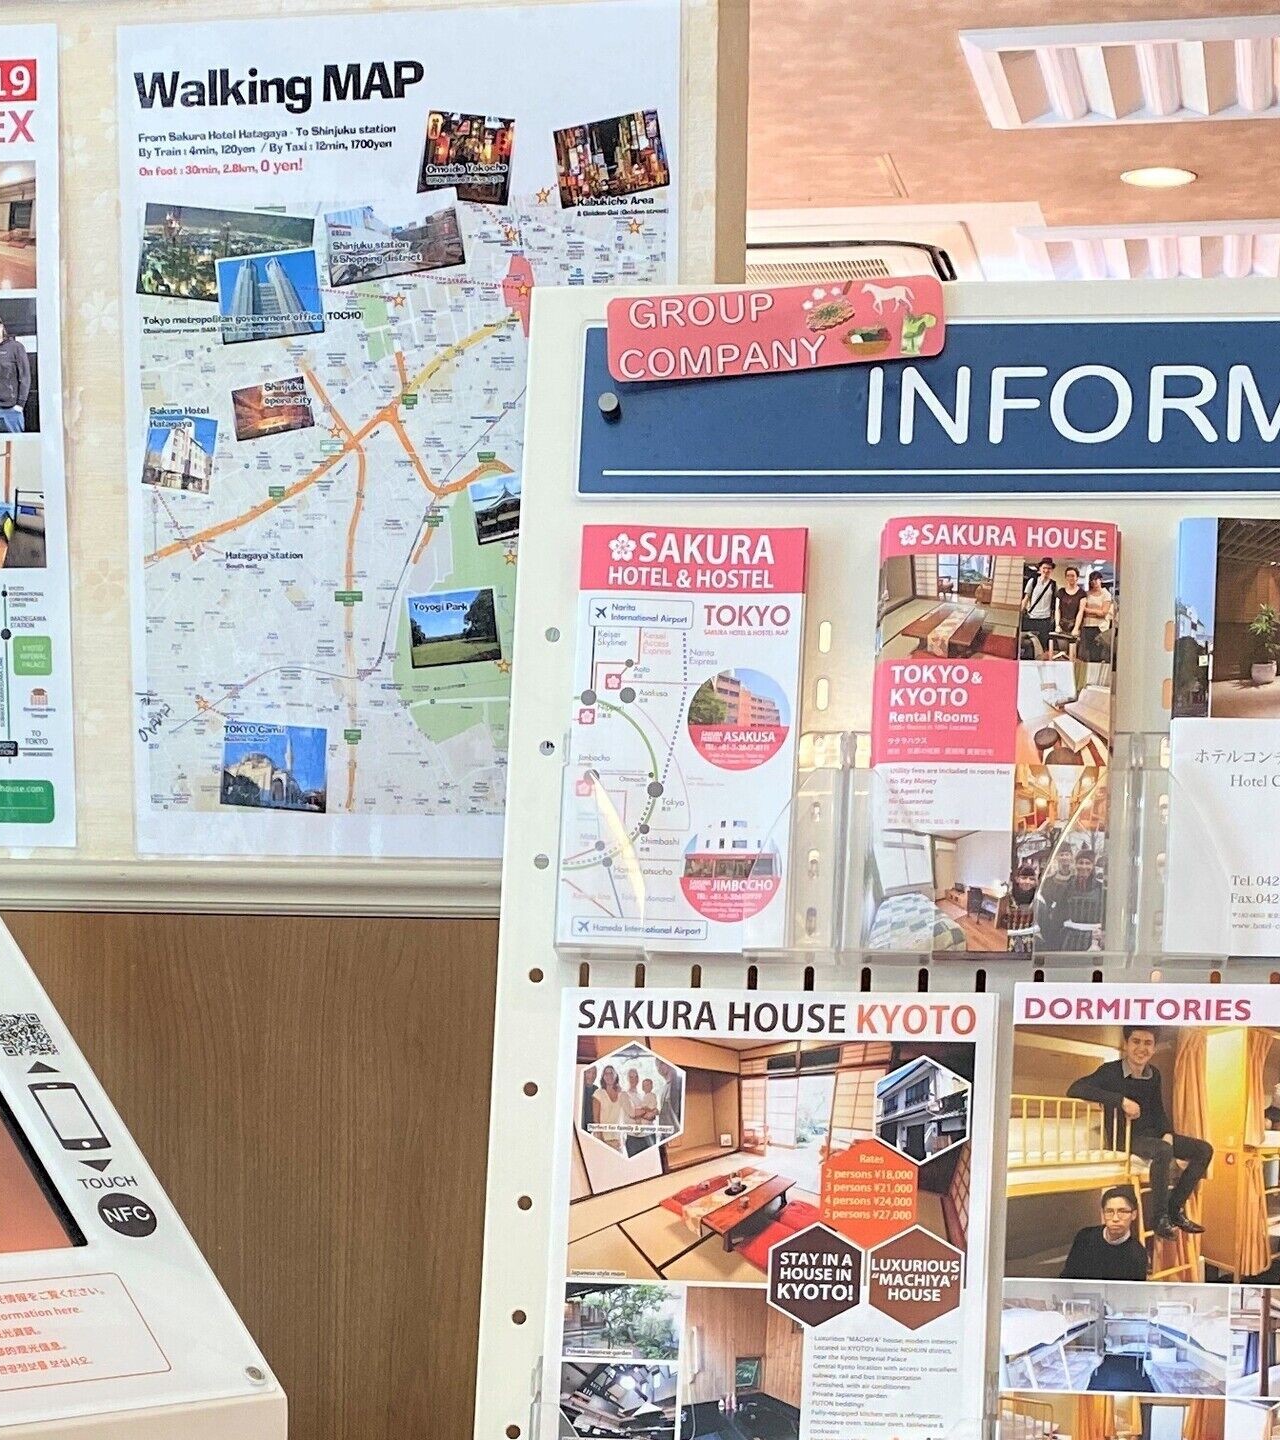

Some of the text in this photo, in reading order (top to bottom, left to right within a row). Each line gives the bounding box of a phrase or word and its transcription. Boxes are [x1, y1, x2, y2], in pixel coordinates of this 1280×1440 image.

[134, 61, 425, 114] Walking MAP
[627, 293, 774, 330] GROUP
[619, 336, 826, 380] COMPANY
[921, 524, 1107, 550] SAKURA HOUSE
[639, 531, 775, 565] SAKURA
[224, 550, 304, 564] Hatagaya station
[609, 566, 773, 589] HOTEL & HOSTEL
[414, 602, 468, 614] Yoyogi Park
[704, 605, 791, 627] TOKYO
[891, 665, 982, 684] TOKYO &
[890, 688, 968, 706] KYOTO
[889, 710, 980, 723] Rental Rooms
[723, 732, 775, 743] ASAKUSA
[1230, 774, 1268, 789] Hotel
[712, 880, 773, 892] JIMBOCHO
[578, 999, 977, 1035] SAKURA HOUSE KYOTO
[1024, 998, 1251, 1021] DORMITORIES
[77, 1175, 138, 1190] TOUCH
[103, 1206, 151, 1223] NFC
[780, 1252, 852, 1266] STAY IN A
[871, 1258, 959, 1273] LUXURIOUS
[780, 1266, 851, 1280] HOUSE IN
[777, 1283, 853, 1301] KYOTO!
[888, 1287, 940, 1301] HOUSE
